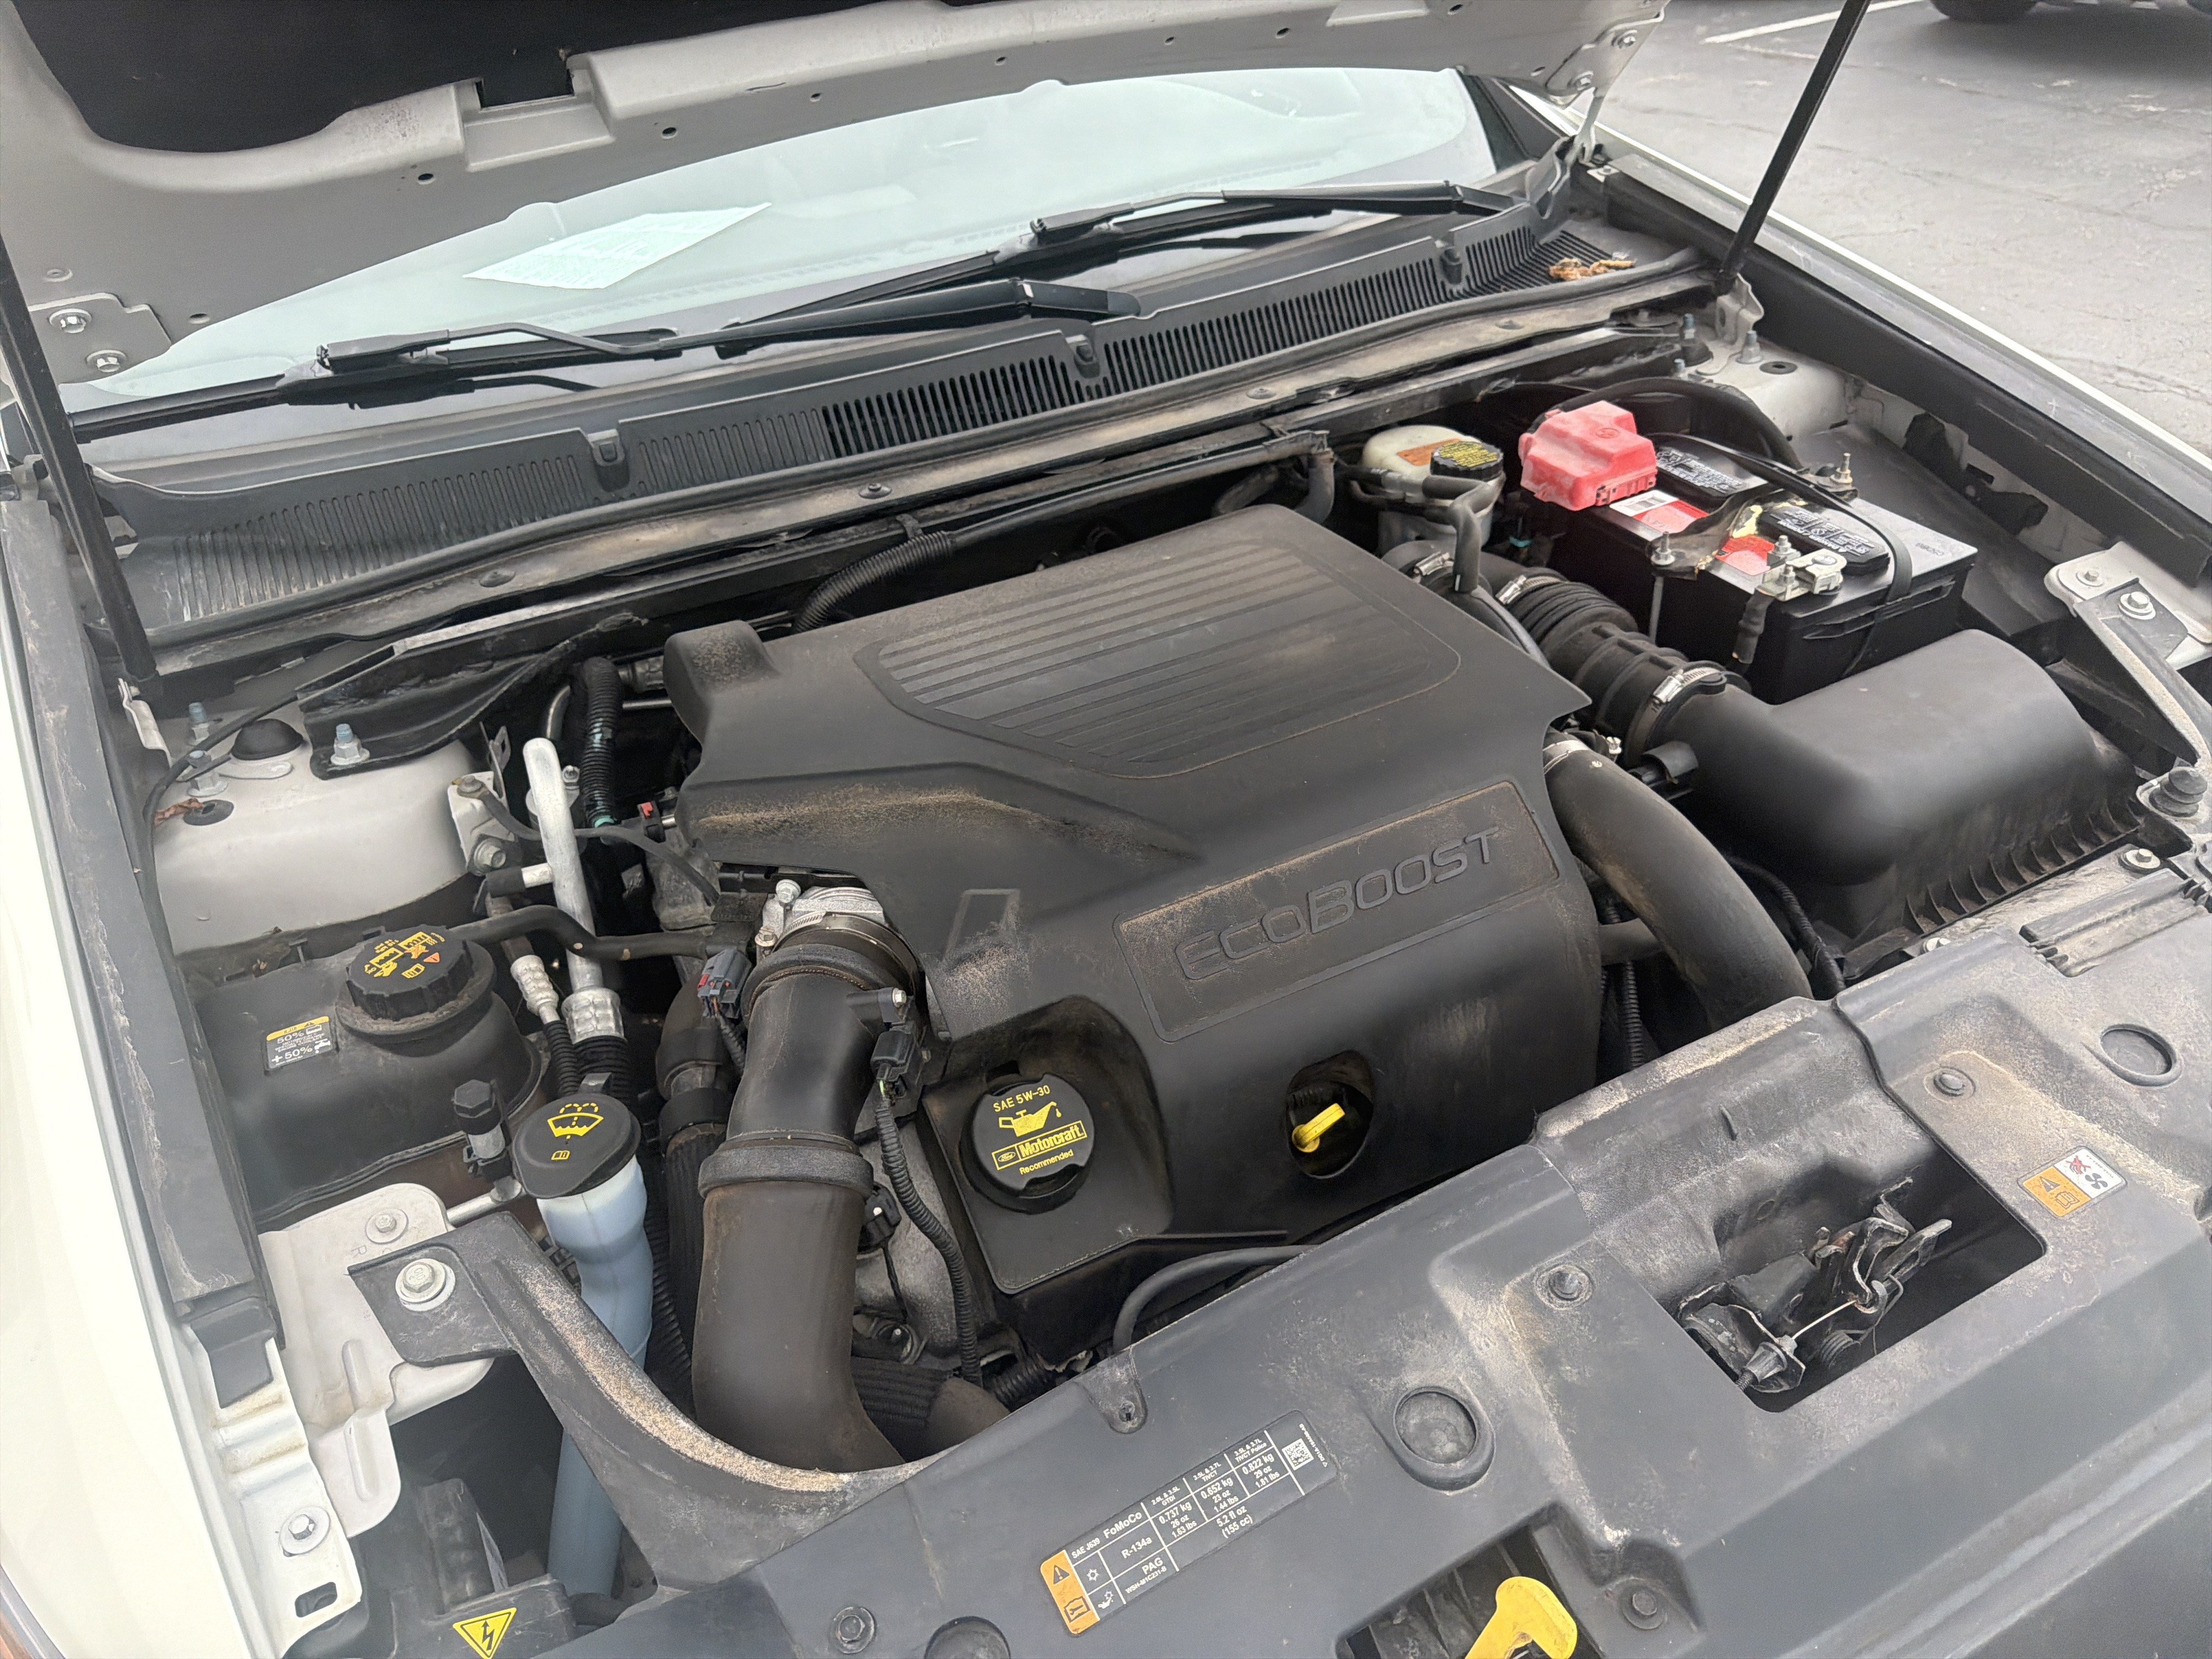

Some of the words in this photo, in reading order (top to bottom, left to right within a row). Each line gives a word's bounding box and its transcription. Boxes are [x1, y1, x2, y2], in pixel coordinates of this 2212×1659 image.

[277, 1031, 304, 1044] 50%
[285, 1045, 313, 1059] 50%
[993, 1097, 1014, 1113] SAE
[1015, 1085, 1051, 1104] 5W-30
[1018, 1125, 1083, 1158] Motorcraft
[1019, 1149, 1074, 1175] Recommended
[1234, 1447, 1246, 1456] 3.5L
[1250, 1438, 1262, 1447] 3.7L
[1251, 1442, 1267, 1454] Police
[1193, 1471, 1205, 1481] 3.5L
[1209, 1462, 1221, 1471] 3.7L
[1242, 1458, 1263, 1475] 0.822
[1262, 1453, 1274, 1463] kg
[1254, 1470, 1263, 1479] 29
[1255, 1476, 1269, 1488] 1.81
[1268, 1471, 1280, 1481] lbs
[1152, 1496, 1164, 1505] 2.0L
[1168, 1486, 1180, 1495] 3.5L
[1200, 1482, 1222, 1499] 0.652
[1221, 1477, 1233, 1487] kg
[1212, 1494, 1222, 1504] 23
[1214, 1501, 1228, 1513] 1.44
[1227, 1496, 1239, 1506] lbs
[1159, 1506, 1179, 1524] 0.737
[1180, 1502, 1192, 1512] kg
[1170, 1519, 1180, 1529] 26
[1180, 1514, 1189, 1523] oz
[1216, 1515, 1230, 1527] 5.2
[1228, 1511, 1236, 1520] fl
[1236, 1505, 1248, 1516] oz
[1103, 1513, 1142, 1539] FoMoCo
[1172, 1526, 1186, 1538] 1.63
[1185, 1520, 1198, 1531] lbs
[1222, 1522, 1239, 1539] (155
[1239, 1514, 1253, 1526] cc)
[1071, 1546, 1086, 1559] SAE
[1086, 1538, 1101, 1550] J639
[1121, 1537, 1152, 1559] R-134a
[1142, 1557, 1163, 1575] PAG
